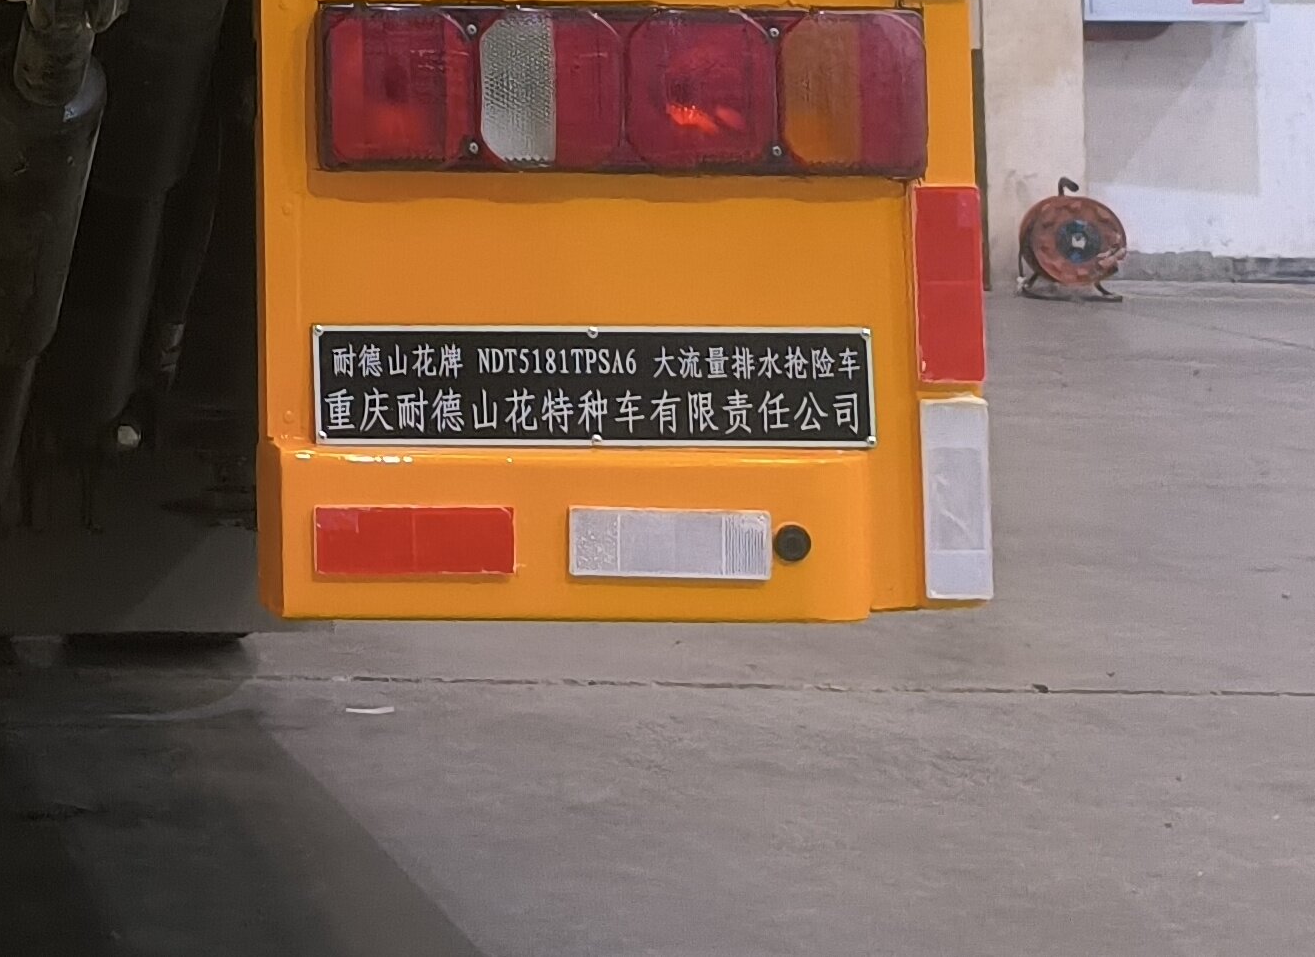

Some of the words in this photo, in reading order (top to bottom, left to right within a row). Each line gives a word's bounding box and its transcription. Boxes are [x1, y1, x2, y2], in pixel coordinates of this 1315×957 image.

[331, 342, 464, 379] 耐德山花牌
[477, 347, 637, 375] NDT5181TPSA6
[653, 345, 860, 380] 大流量排水抢险车
[324, 386, 860, 435] 重庆耐德山花特种车有限责任公司
